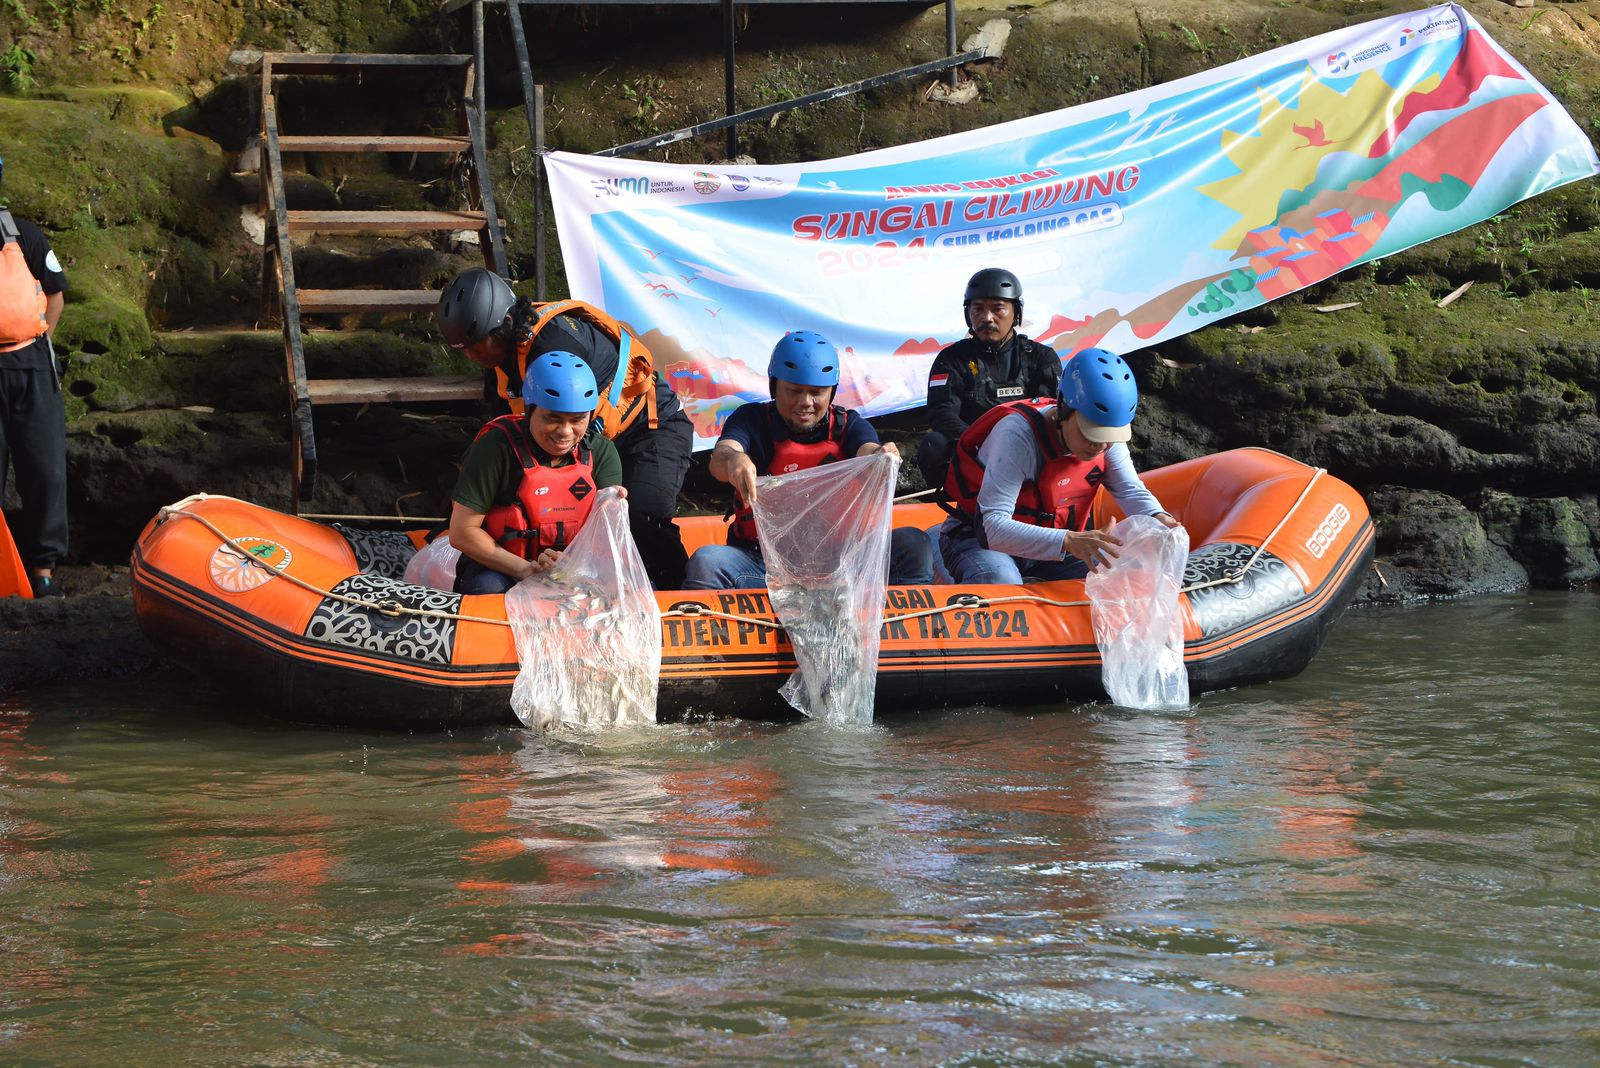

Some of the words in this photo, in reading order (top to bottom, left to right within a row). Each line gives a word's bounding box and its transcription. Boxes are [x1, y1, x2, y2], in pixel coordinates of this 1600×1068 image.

[1352, 45, 1392, 64] PRESENCE
[650, 186, 685, 194] INDONESIA
[962, 168, 1061, 190] EDUKASI
[792, 200, 954, 241] SUNGAI
[964, 165, 1140, 222] CILIWUNG
[986, 213, 1070, 243] HOLDING
[1075, 207, 1116, 226] GAS
[1306, 504, 1350, 558] BOOGIE
[954, 609, 1030, 639] 2024
